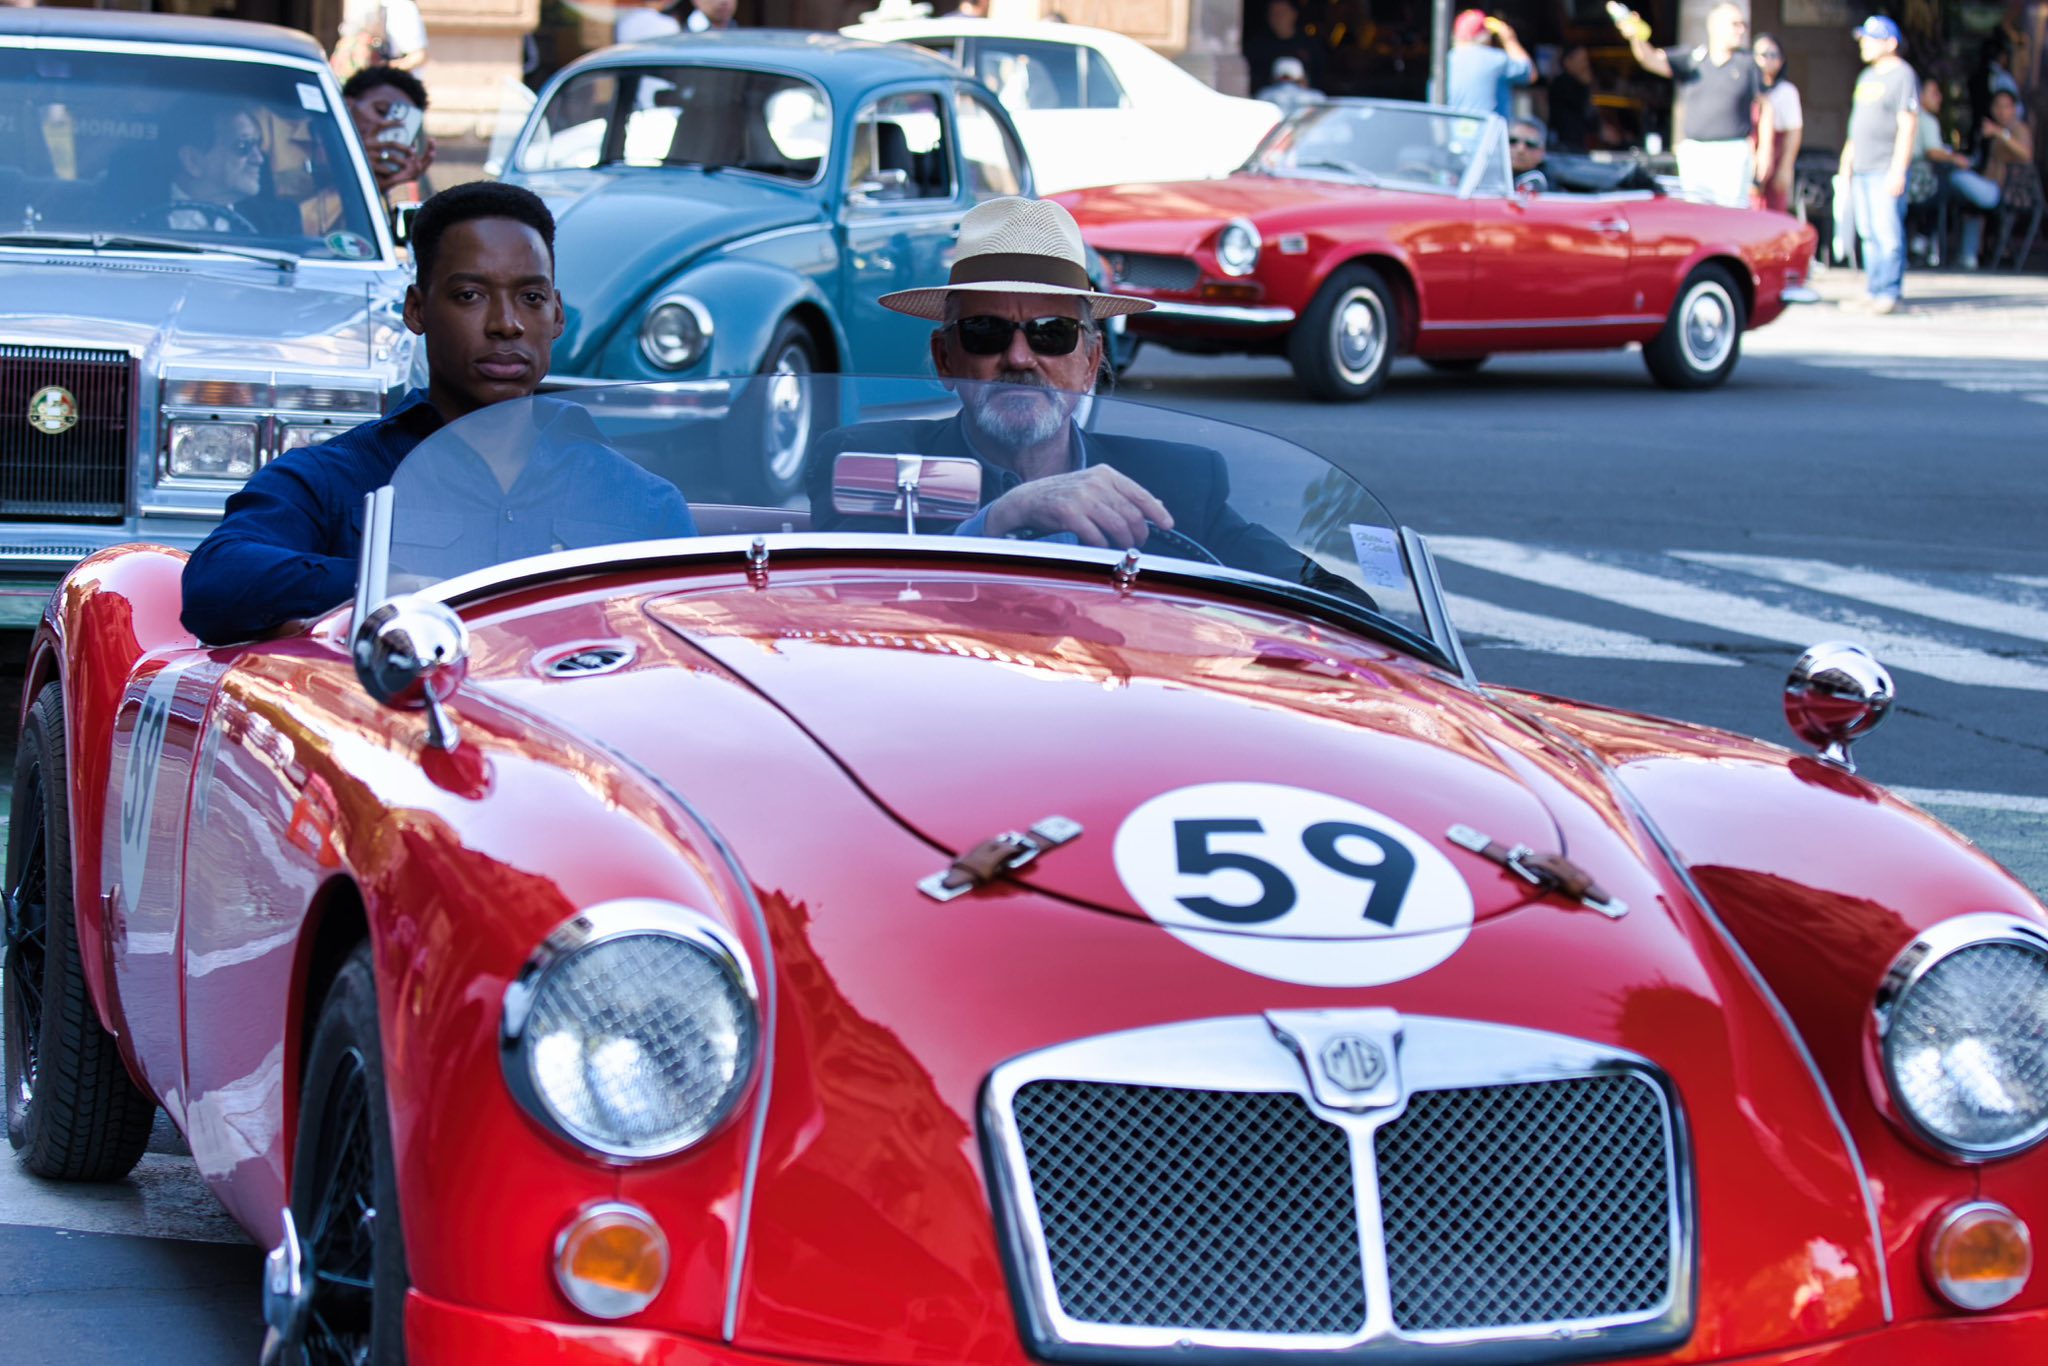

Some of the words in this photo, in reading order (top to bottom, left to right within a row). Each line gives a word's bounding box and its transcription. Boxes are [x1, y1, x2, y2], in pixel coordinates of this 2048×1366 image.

[124, 694, 166, 853] 59
[1173, 818, 1416, 928] 59
[1329, 1037, 1383, 1088] MG
